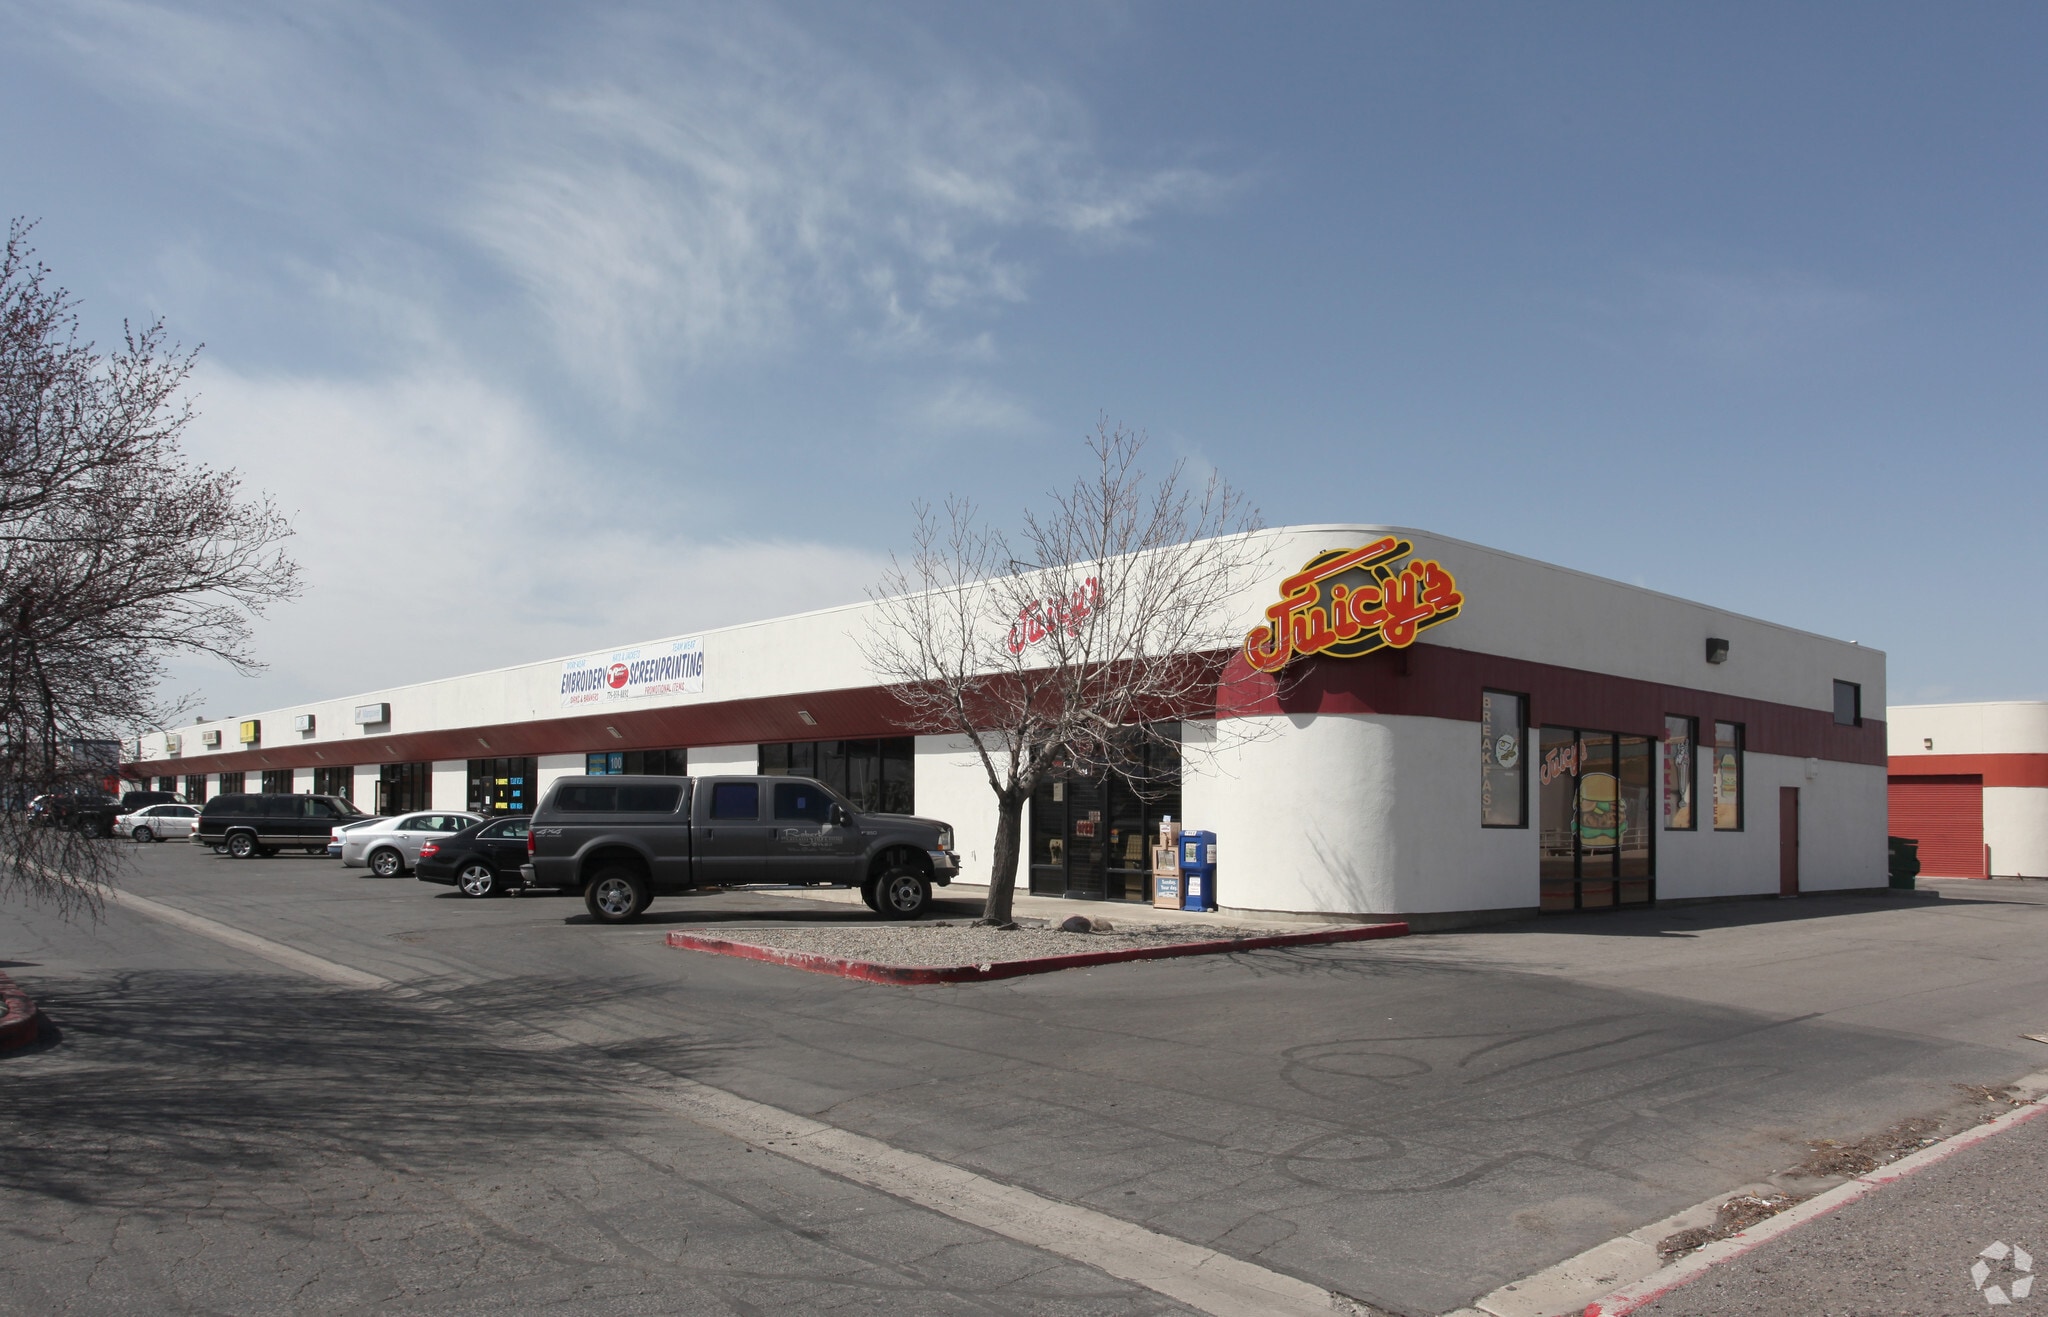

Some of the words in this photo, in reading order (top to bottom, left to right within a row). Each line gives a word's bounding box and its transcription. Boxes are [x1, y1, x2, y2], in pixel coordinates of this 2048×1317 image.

[1244, 535, 1465, 673] Juicy's
[561, 665, 608, 694] EMBROIDERY
[628, 651, 703, 686] SCREENPRINTING
[1482, 696, 1492, 820] BREAKFAST
[1663, 727, 1672, 816] SHAKES
